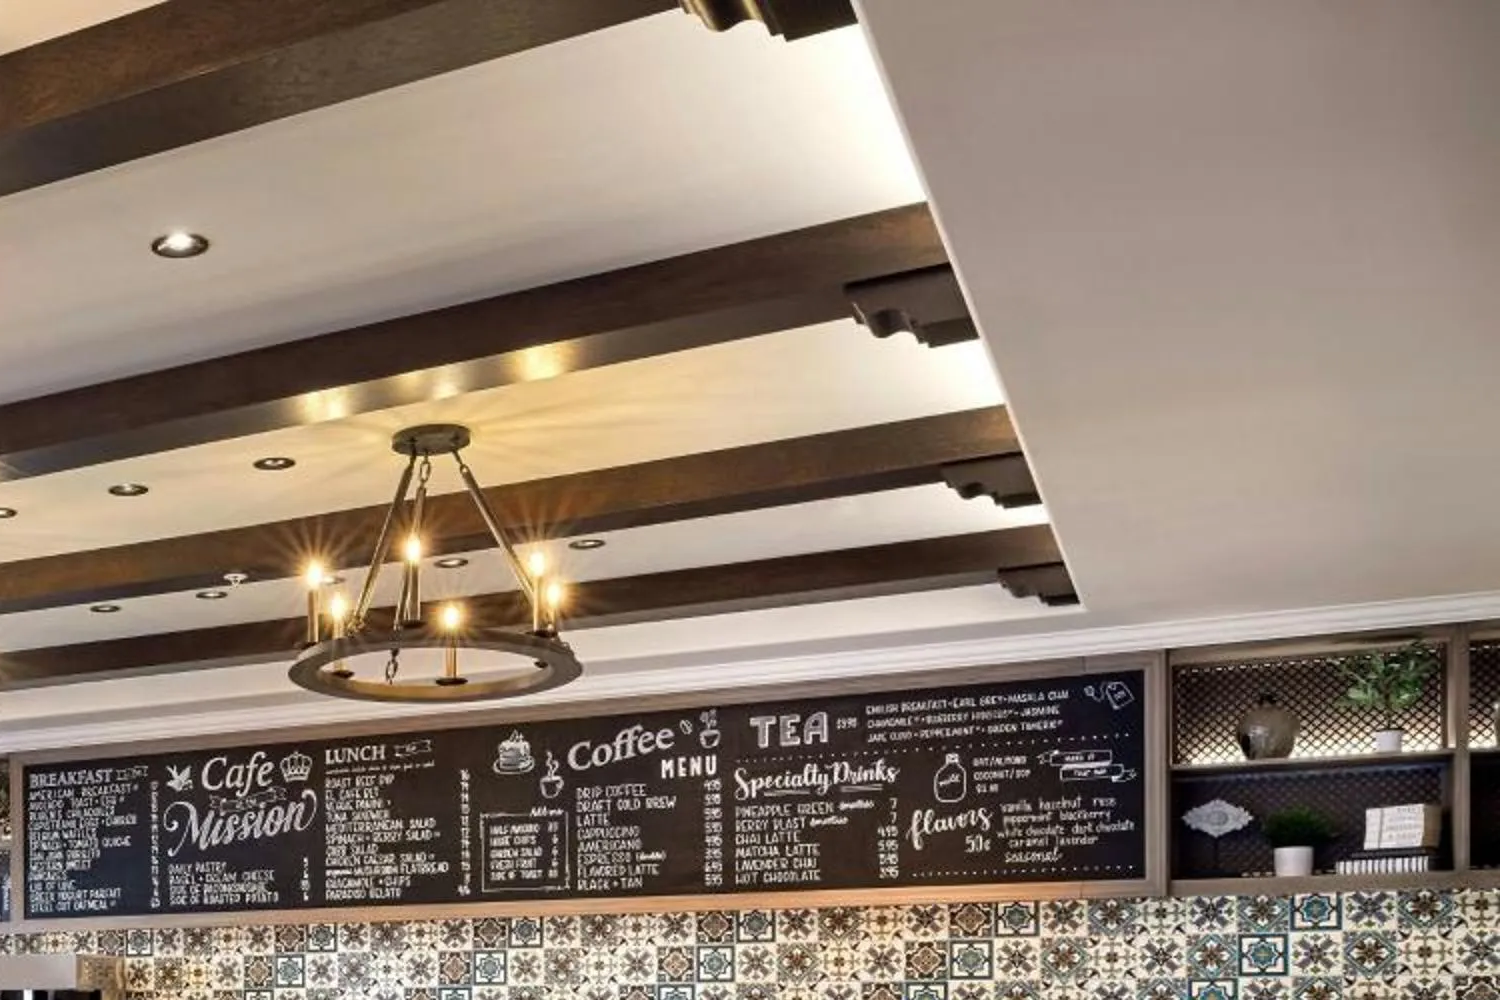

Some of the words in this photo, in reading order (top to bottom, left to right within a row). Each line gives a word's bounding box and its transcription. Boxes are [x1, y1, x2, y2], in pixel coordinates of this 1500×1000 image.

[953, 697, 977, 709] EARL
[749, 711, 829, 749] TEA
[325, 745, 386, 765] LUNCH
[566, 724, 675, 771] Coffee
[201, 751, 274, 797] Cafe
[660, 754, 718, 780] MENU
[29, 768, 113, 788] BREAKFAST
[733, 762, 830, 800] Specialty
[826, 757, 901, 786] Drinks
[29, 788, 75, 801] AMERICAN
[81, 782, 132, 797] BREAKFAST
[576, 786, 603, 800] DRIP
[605, 783, 647, 798] COFFEE
[576, 799, 611, 814] DRAFT
[617, 797, 641, 811] COLD
[645, 795, 677, 809] BREW
[735, 803, 792, 818] PINEAPPLE
[797, 801, 834, 815] GREEN
[163, 789, 318, 857] Mission
[325, 819, 404, 833] MEDITERRANEAN
[409, 817, 436, 830] SALAD
[576, 813, 610, 827] LATTE
[735, 818, 769, 832] BERRY
[772, 816, 806, 830] BLAST
[405, 828, 432, 842] SALAD
[577, 825, 641, 840] CAPPUCCINO
[906, 807, 994, 851] flavors
[577, 838, 642, 853] AMERICANO
[735, 832, 761, 845] CHAI
[765, 830, 801, 844] LATTE
[577, 851, 631, 866] ESPRESSO
[735, 845, 780, 859] MATCHA
[784, 843, 821, 857] LATTE
[577, 864, 627, 879] FLAVORED
[628, 863, 660, 877] LATTE
[735, 857, 790, 871] LAVENDER
[792, 855, 818, 869] CHAI
[577, 877, 611, 891] BLACK
[620, 875, 642, 889] TAN
[735, 871, 759, 885] HOT
[763, 869, 821, 883] CHOCOLATE
